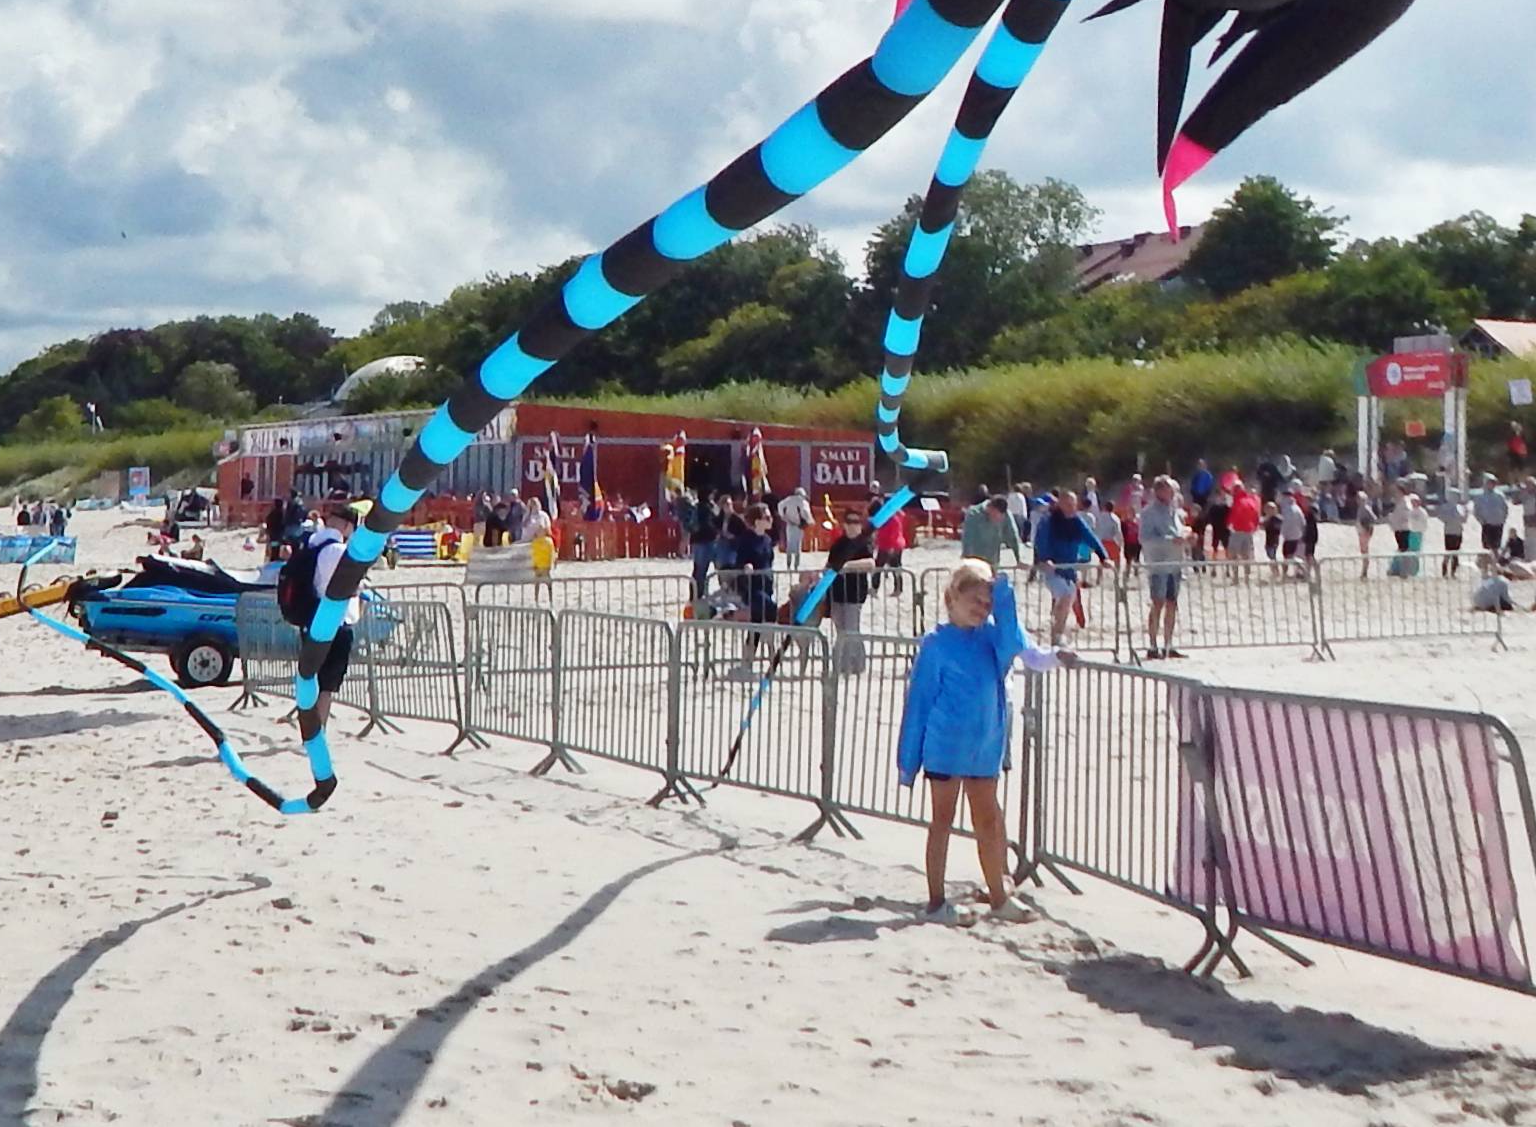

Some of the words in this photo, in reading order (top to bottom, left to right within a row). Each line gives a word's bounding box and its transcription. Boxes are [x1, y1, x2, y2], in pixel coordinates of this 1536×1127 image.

[534, 445, 575, 459] SKI
[820, 449, 860, 462] SMAKI
[525, 460, 581, 483] BLI
[814, 462, 866, 485] BALI
